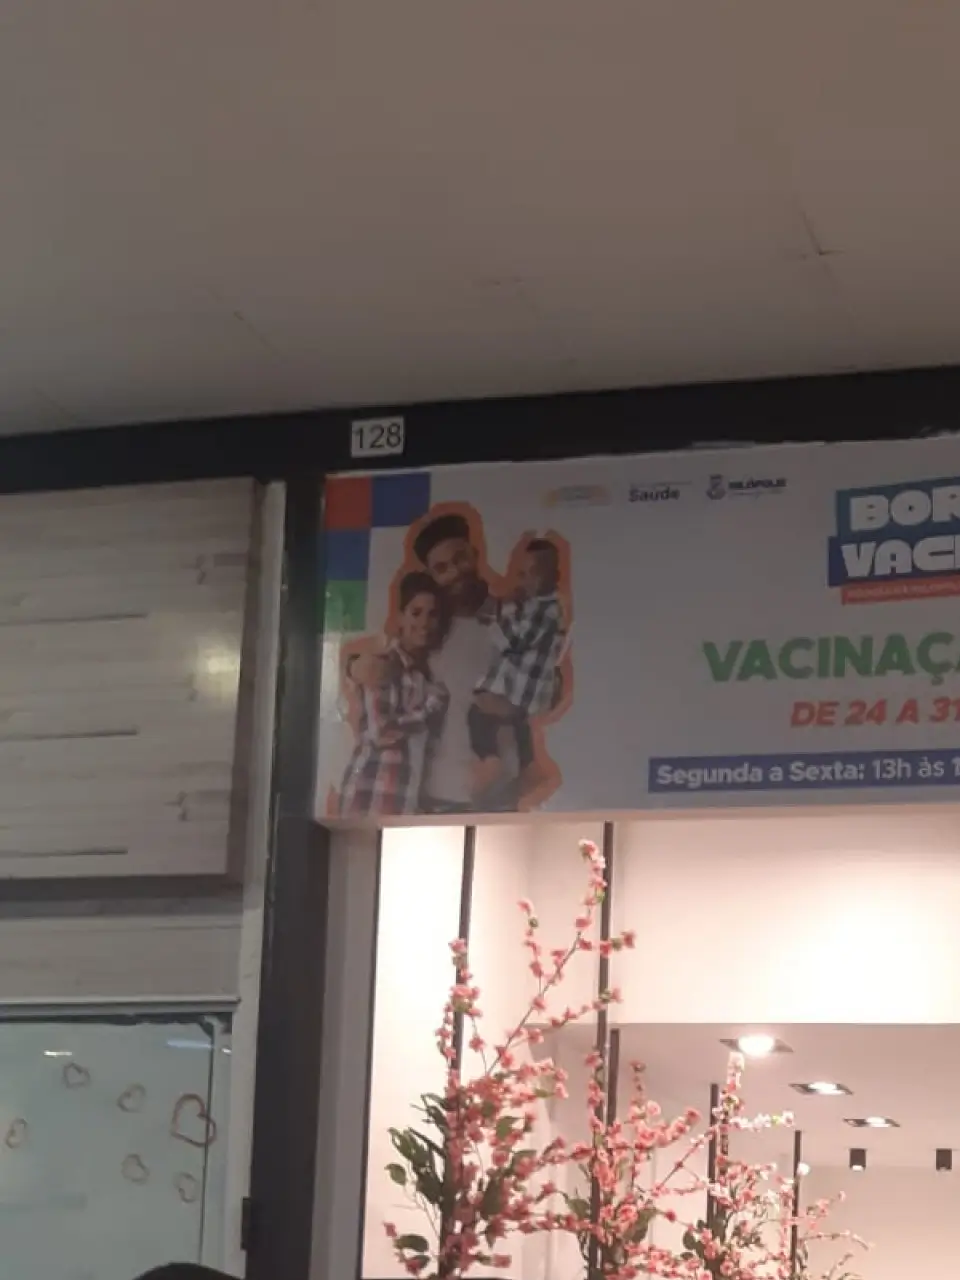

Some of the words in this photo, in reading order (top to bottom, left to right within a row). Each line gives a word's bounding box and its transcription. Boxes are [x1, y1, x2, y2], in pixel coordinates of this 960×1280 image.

[352, 422, 401, 449] 128
[790, 700, 840, 728] DE
[844, 699, 887, 727] 24
[895, 698, 919, 724] A
[656, 762, 763, 789] Segunda
[768, 766, 783, 782] a
[789, 760, 865, 781] Sexta:
[872, 758, 911, 779] 13h
[917, 756, 945, 778] às
